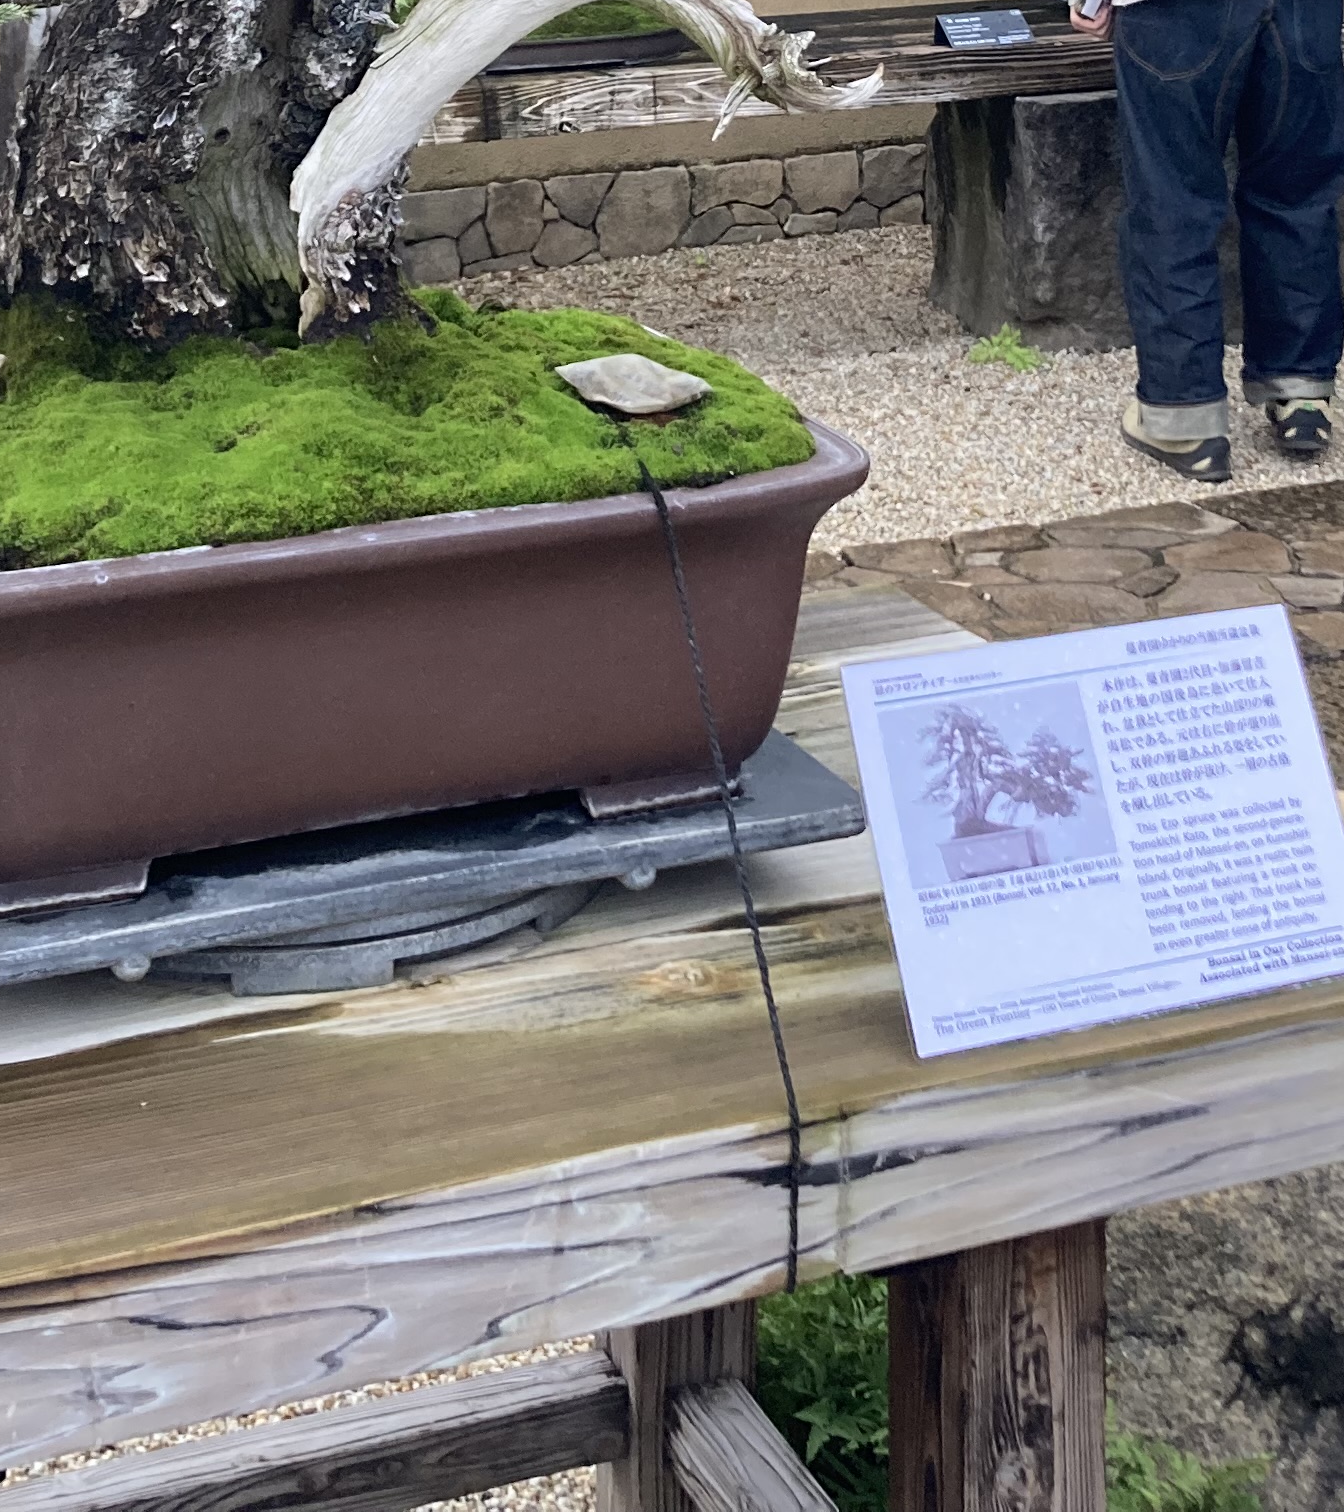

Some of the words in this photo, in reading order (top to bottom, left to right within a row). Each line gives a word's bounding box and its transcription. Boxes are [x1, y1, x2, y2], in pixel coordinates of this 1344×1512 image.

[1135, 822, 1158, 834] This
[1160, 818, 1179, 830] Ezo
[1182, 812, 1216, 827] spruce
[1218, 808, 1239, 819] was
[1287, 796, 1301, 807] by
[1211, 826, 1230, 838] the
[1155, 849, 1182, 864] head
[1182, 846, 1194, 860] of
[1250, 837, 1265, 848] on
[1222, 859, 1232, 870] it
[1232, 856, 1254, 867] was
[1186, 900, 1198, 911] to
[1200, 896, 1219, 908] the
[1303, 876, 1322, 888] has
[1211, 871, 1258, 889] featuring
[970, 894, 991, 907] 1931
[1148, 922, 1176, 936] been
[1272, 899, 1291, 911] the
[1152, 941, 1166, 953] an
[1167, 936, 1192, 949] even
[1193, 928, 1229, 947] greater
[1260, 919, 1271, 931] of
[1206, 950, 1246, 967] Bonsai
[1248, 949, 1261, 959] in
[1262, 945, 1283, 956] Our
[1286, 934, 1343, 952] Collection
[1199, 961, 1260, 983] Associated
[1262, 956, 1288, 970] with
